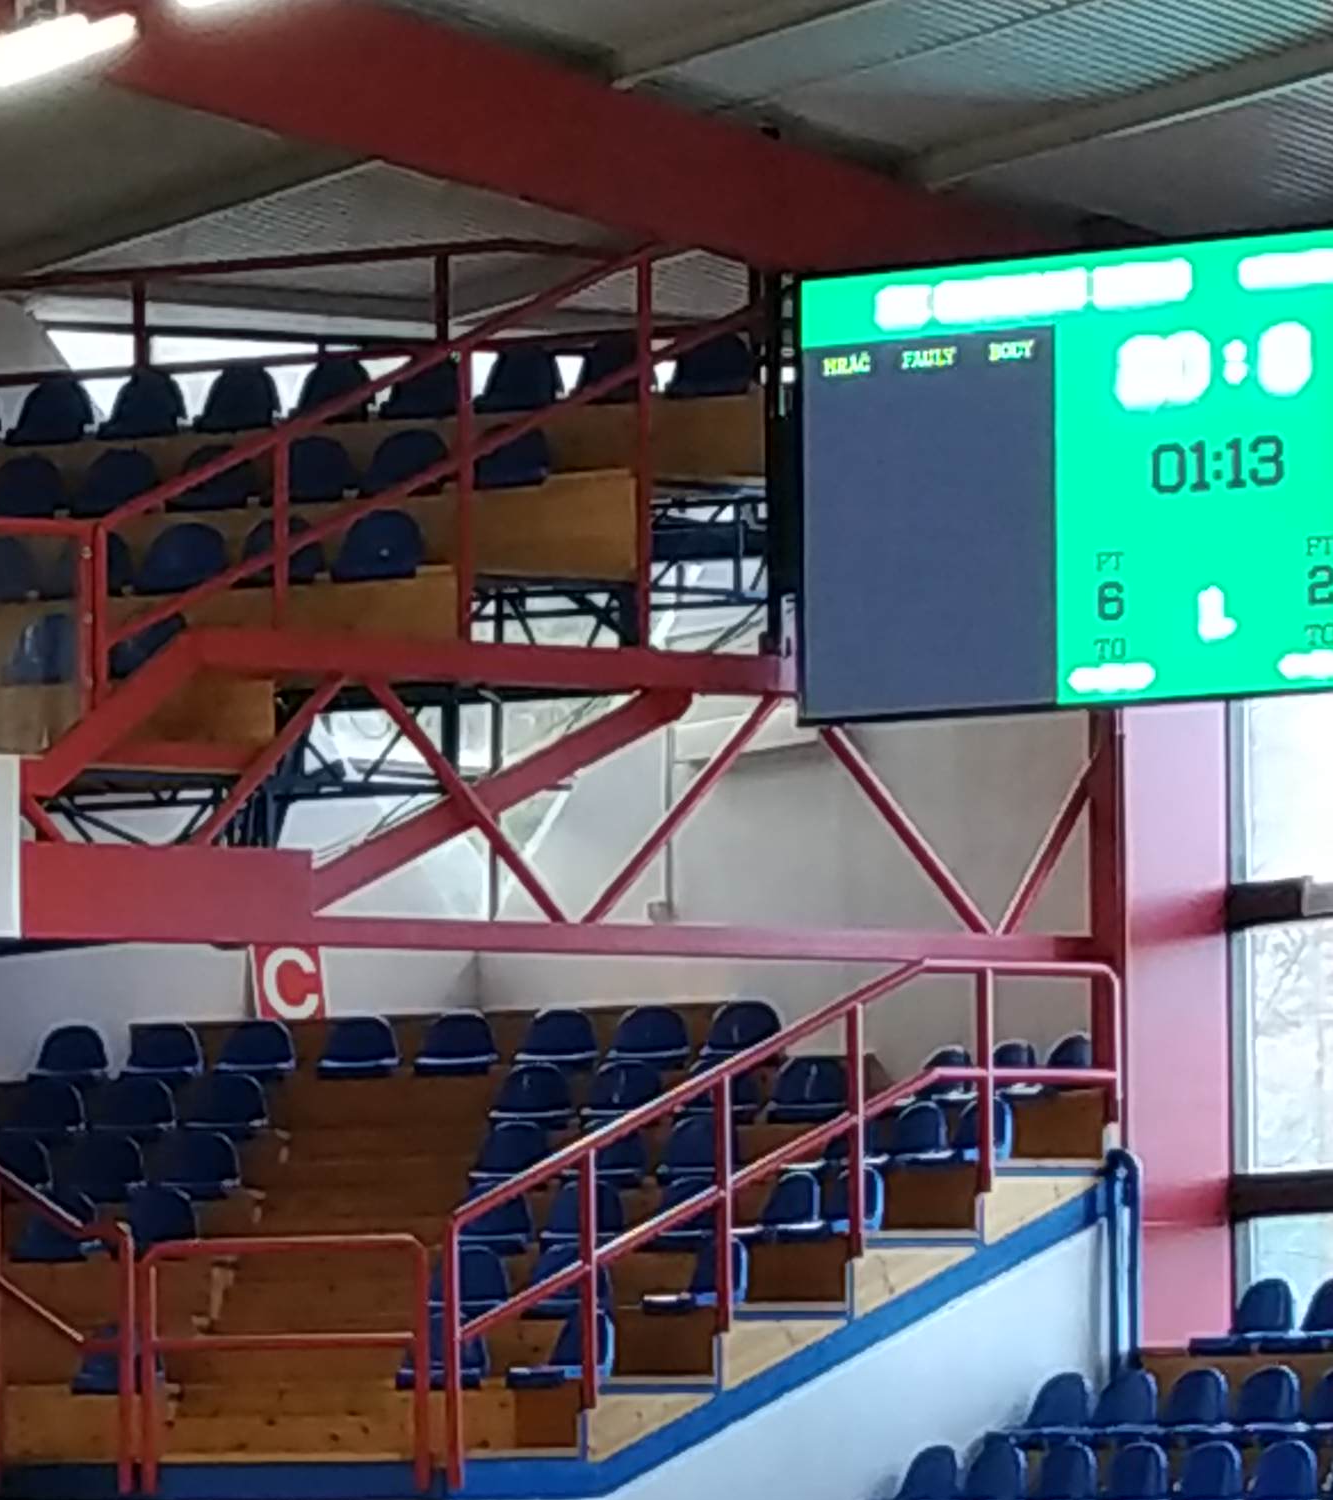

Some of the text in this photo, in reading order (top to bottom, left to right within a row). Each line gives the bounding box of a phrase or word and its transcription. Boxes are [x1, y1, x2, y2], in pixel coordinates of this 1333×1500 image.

[1150, 435, 1284, 494] 01:13
[1097, 565, 1333, 620] 6 2
[262, 947, 320, 1019] C
